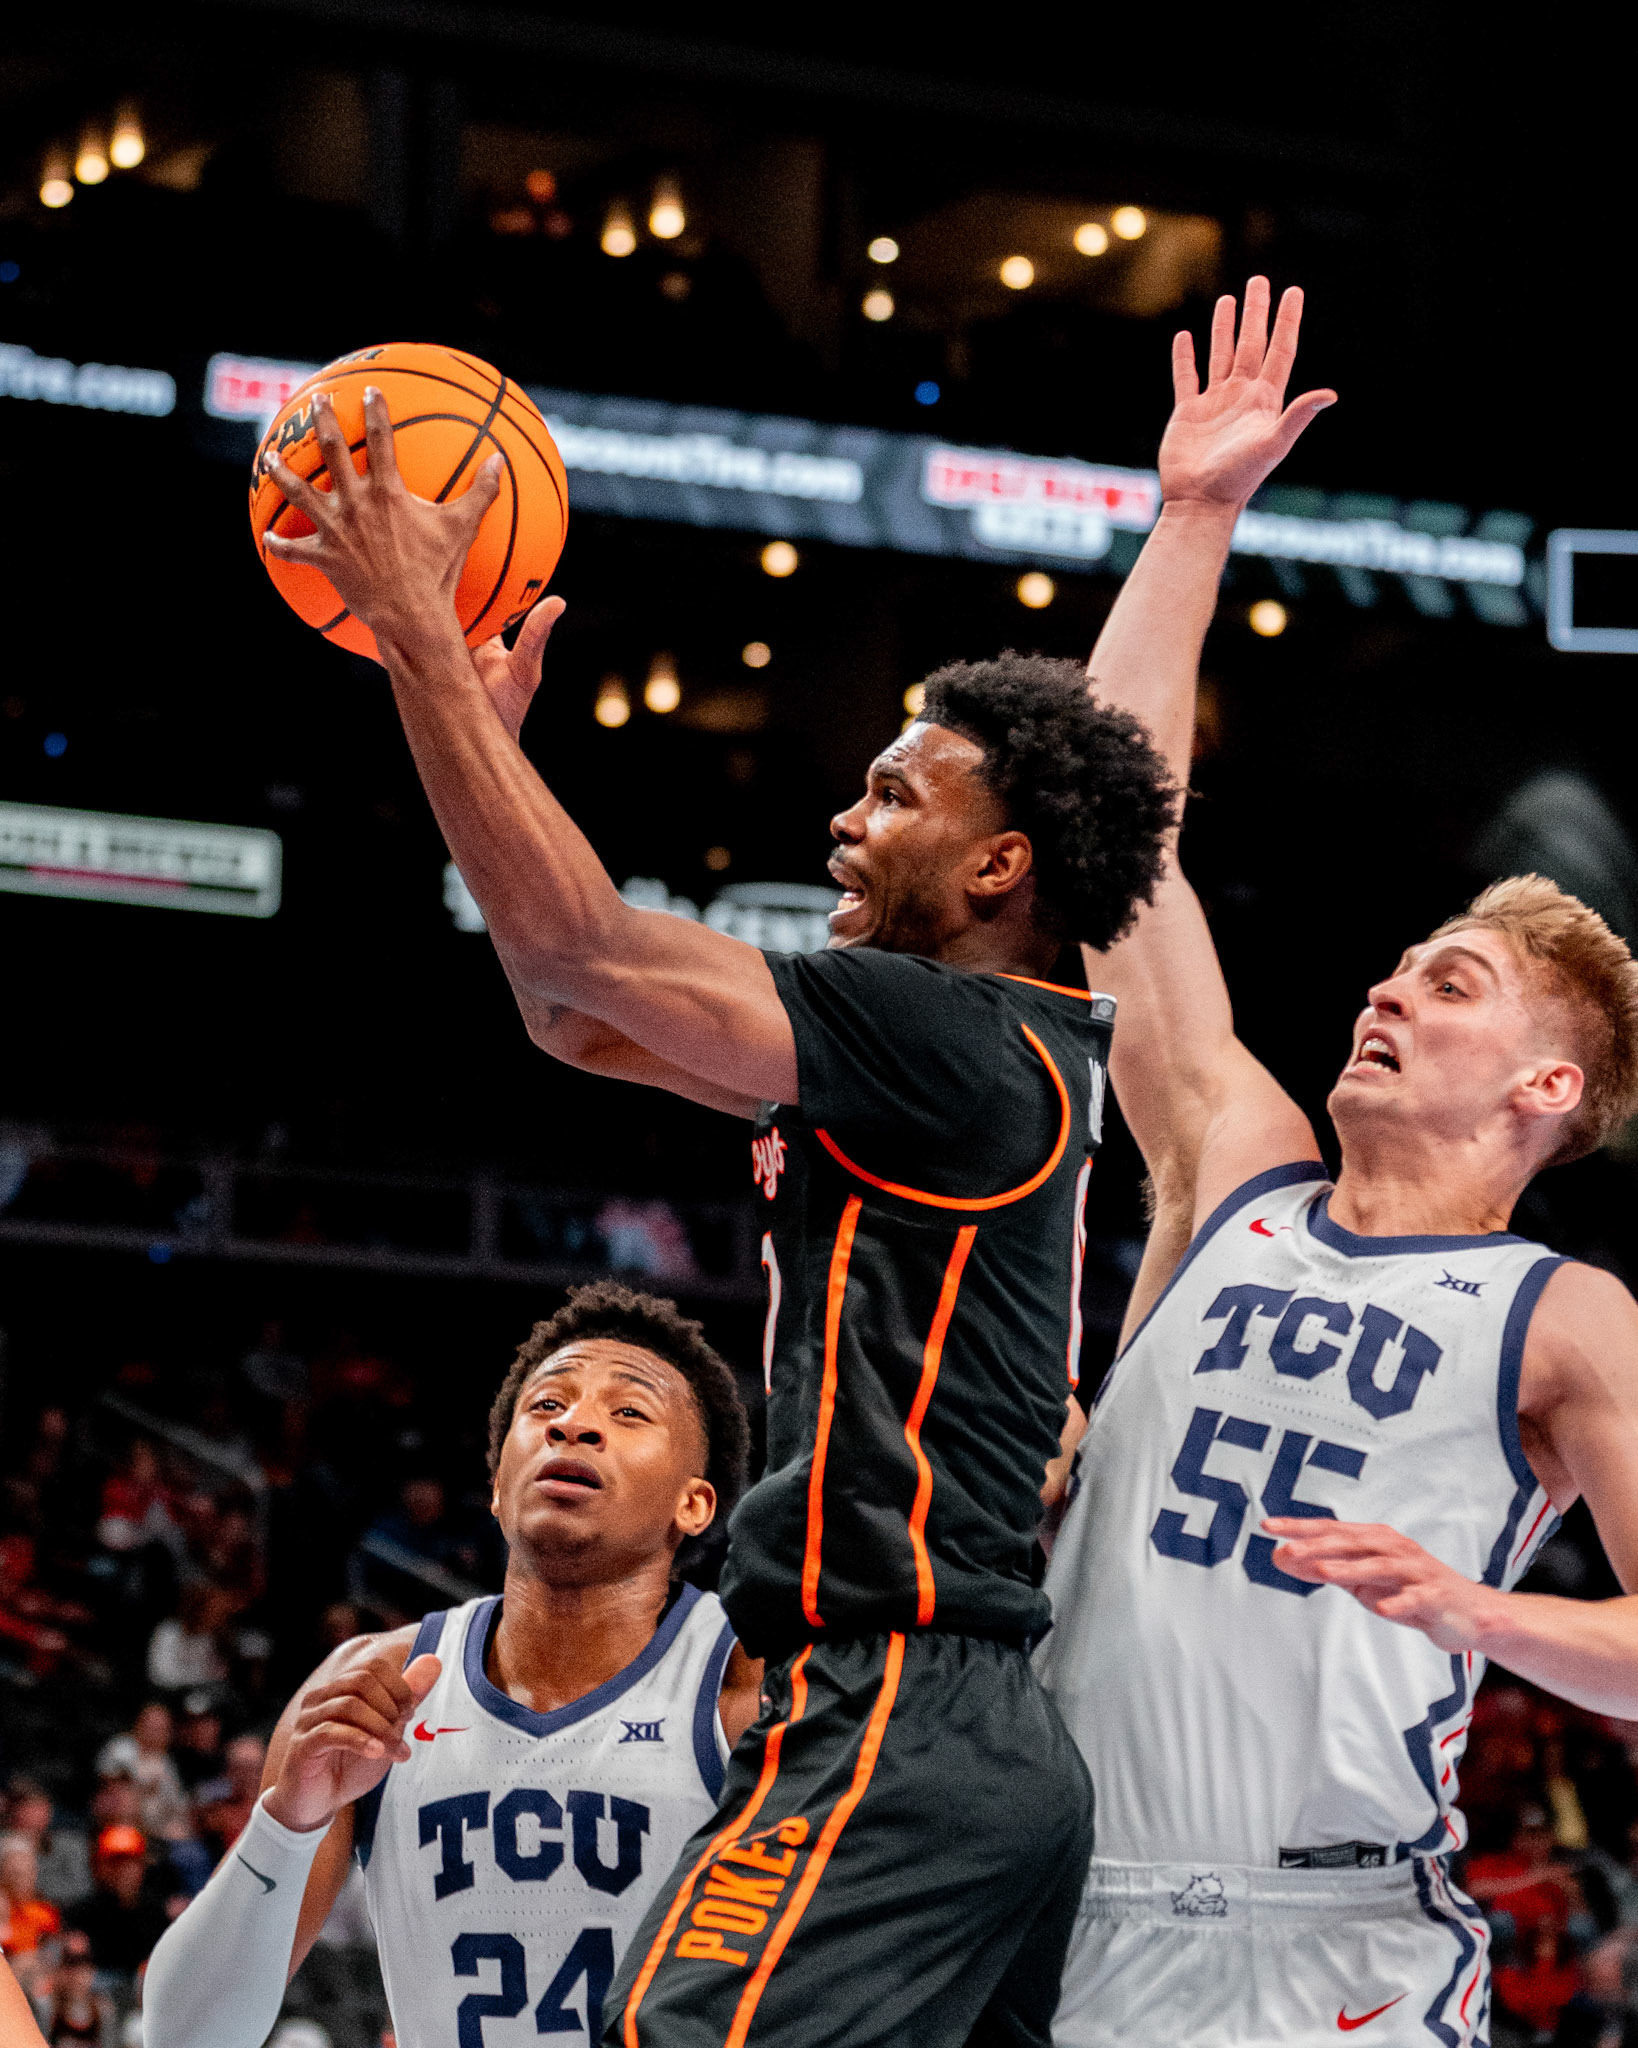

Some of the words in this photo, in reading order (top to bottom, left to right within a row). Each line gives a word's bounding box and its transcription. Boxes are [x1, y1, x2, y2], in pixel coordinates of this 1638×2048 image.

[1193, 1284, 1443, 1420] TCU
[1150, 1406, 1368, 1597] 55
[418, 1788, 650, 1901] TCU
[451, 1927, 616, 2048] 24
